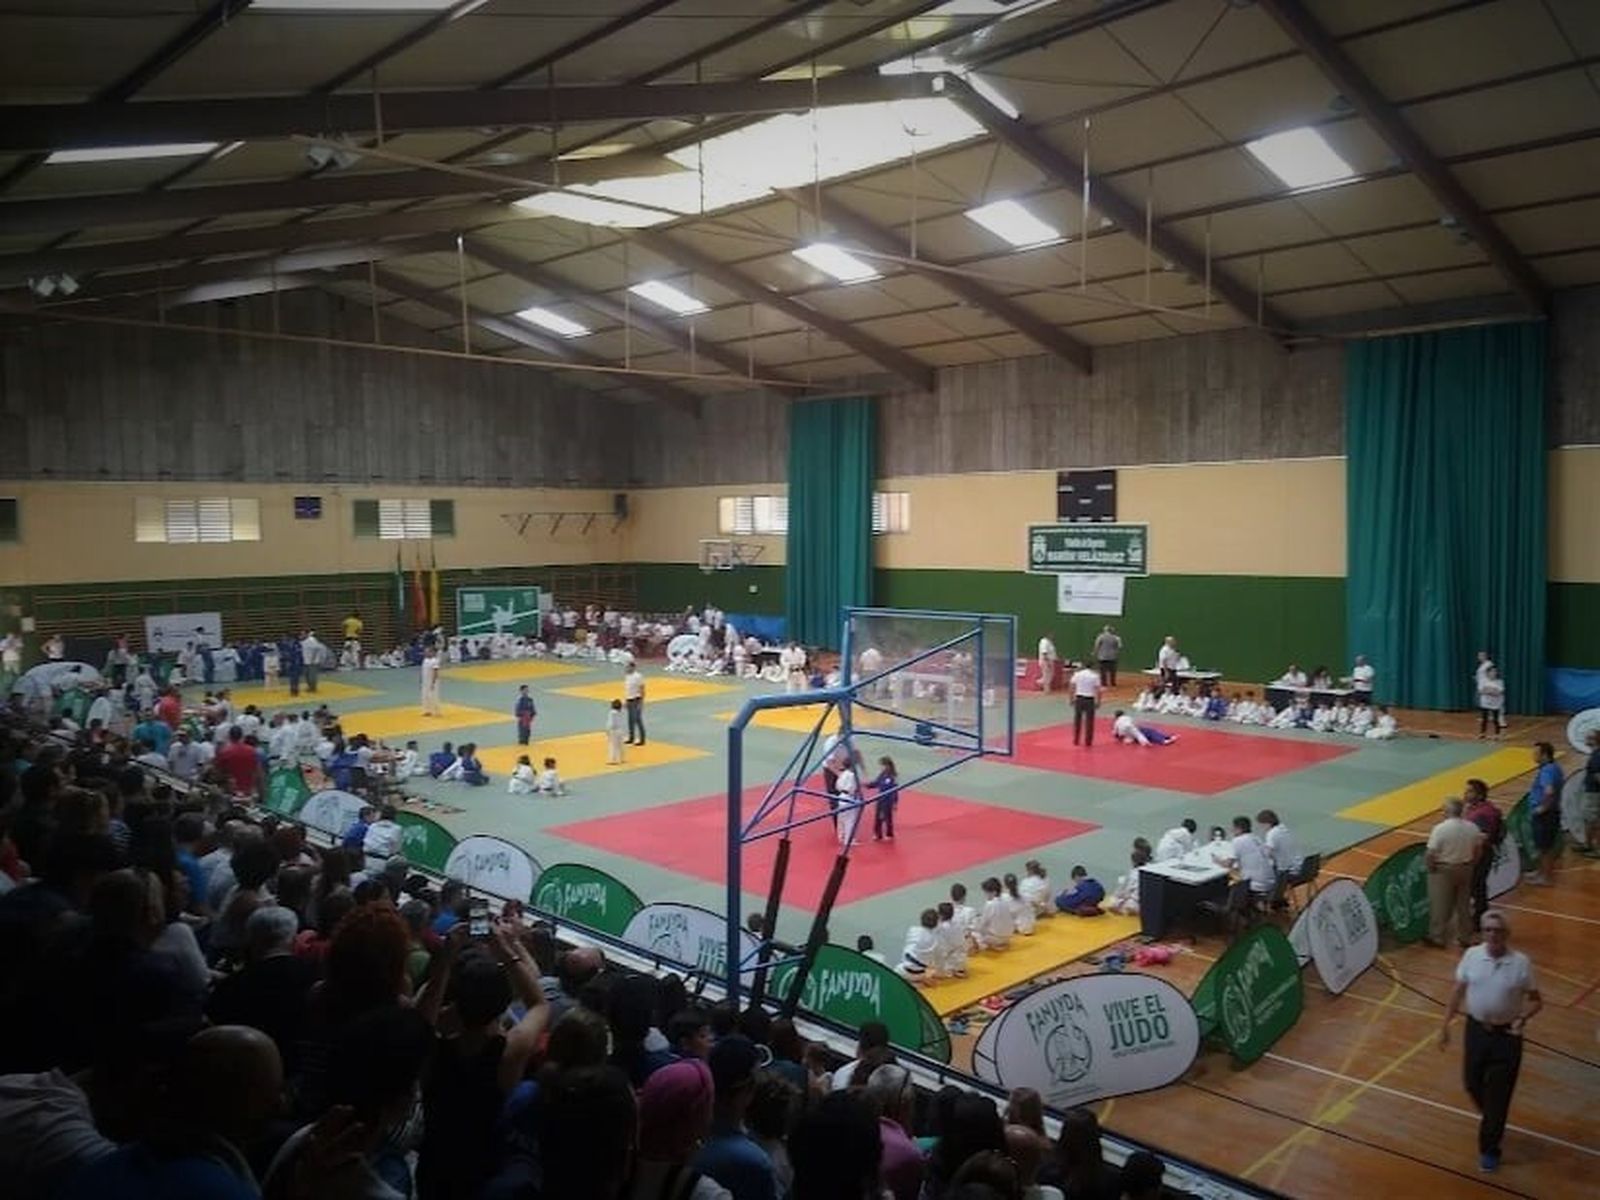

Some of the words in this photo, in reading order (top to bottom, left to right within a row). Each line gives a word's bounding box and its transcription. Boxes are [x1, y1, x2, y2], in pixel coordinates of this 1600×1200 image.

[1102, 997, 1142, 1022] VIVE
[1144, 993, 1166, 1014] EL
[1109, 1013, 1169, 1050] JUDO
